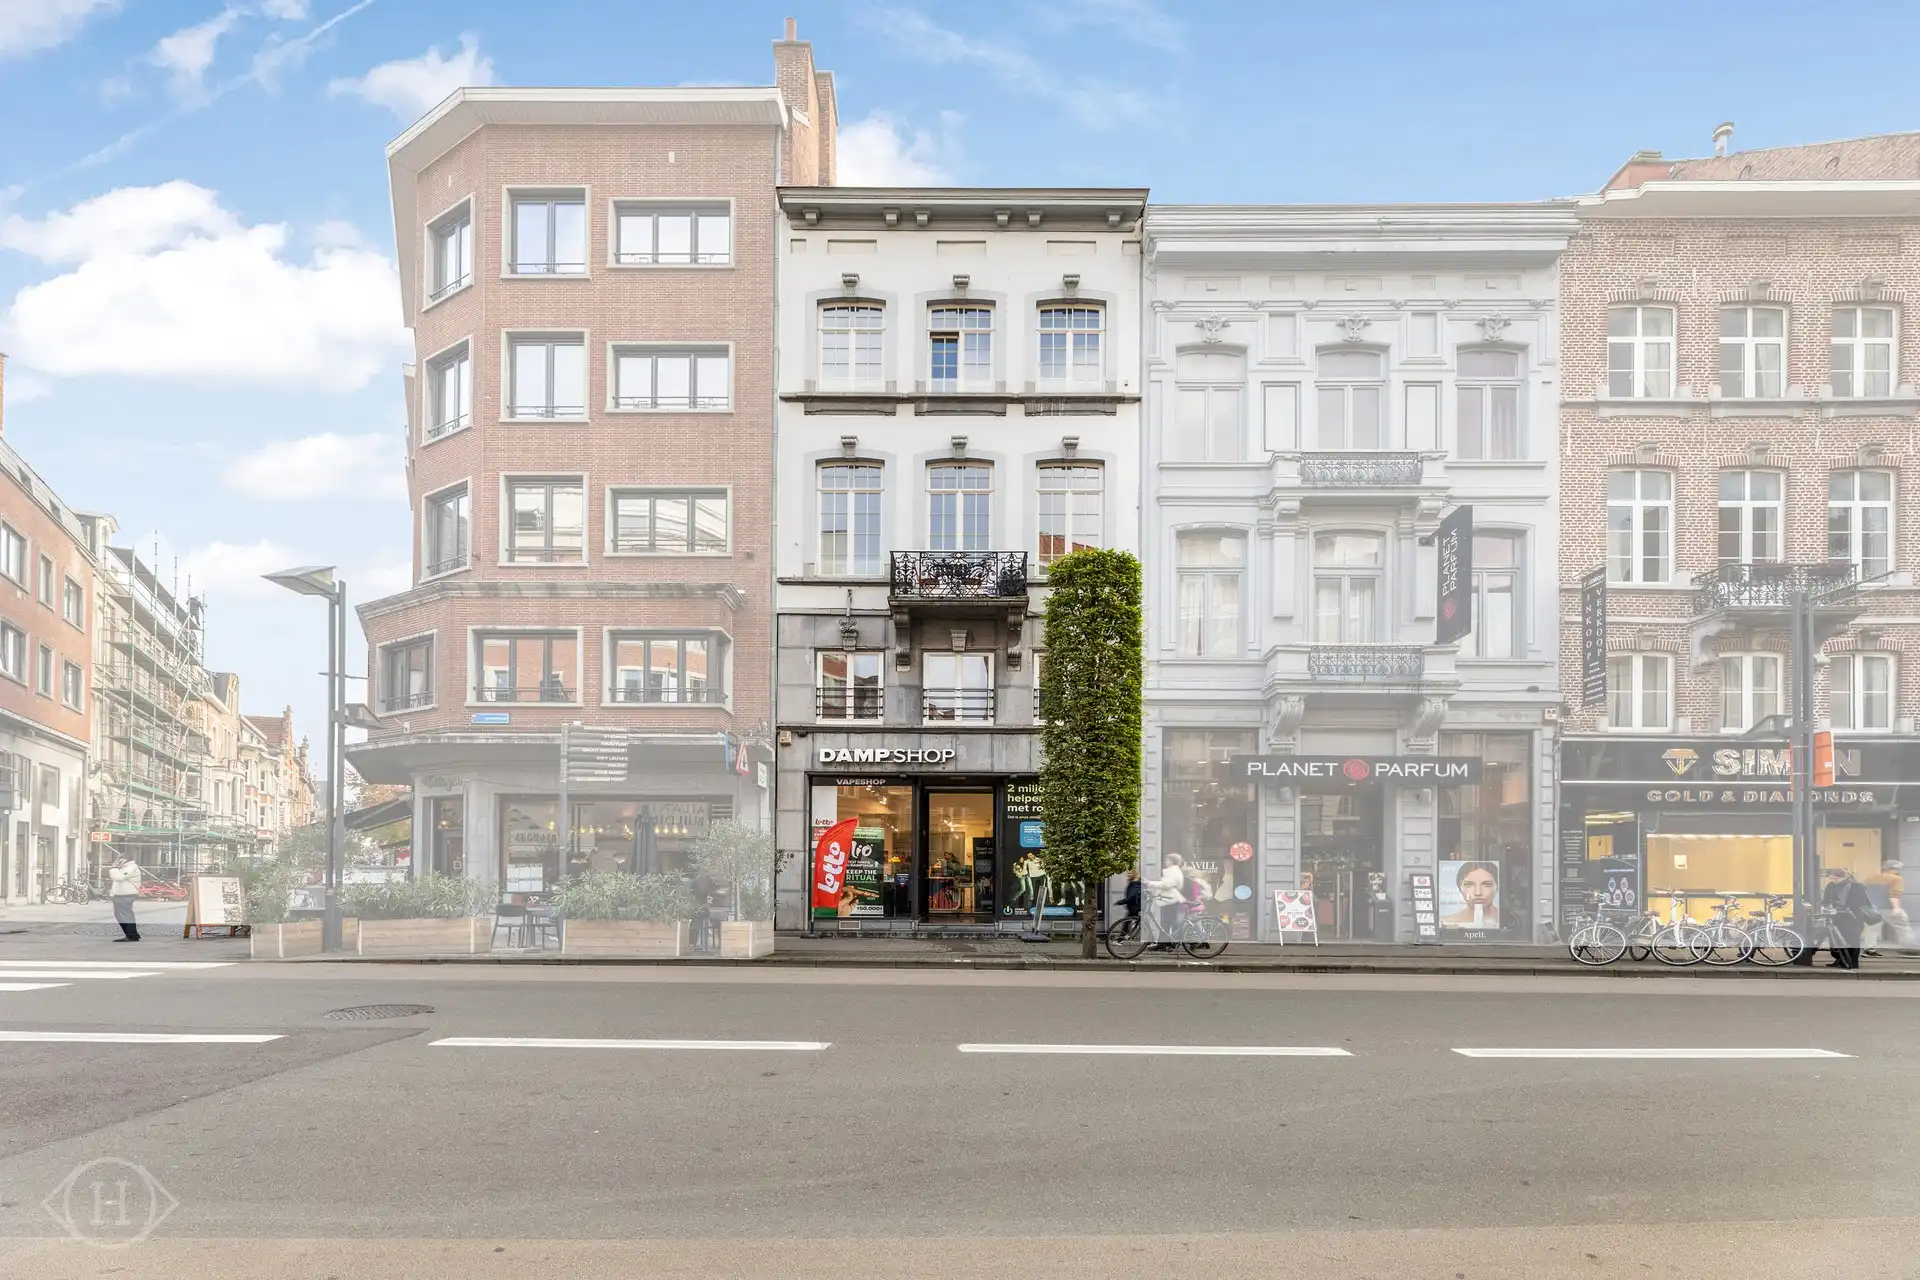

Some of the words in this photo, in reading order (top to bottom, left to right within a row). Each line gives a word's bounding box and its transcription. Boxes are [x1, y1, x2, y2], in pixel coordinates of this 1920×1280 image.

[1442, 537, 1450, 596] PLANET
[1450, 528, 1458, 591] PARFUM
[819, 748, 956, 763] DAMPSHOP
[1712, 749, 1861, 776] SIMN
[1247, 762, 1339, 776] PLANET
[1375, 763, 1468, 777] PARFUM
[1007, 784, 1015, 792] 2
[1018, 784, 1046, 794] miljo
[1647, 790, 1713, 803] GOLD
[1721, 790, 1736, 803] &
[1743, 790, 1874, 803] DIAONDS
[1007, 804, 1029, 812] met
